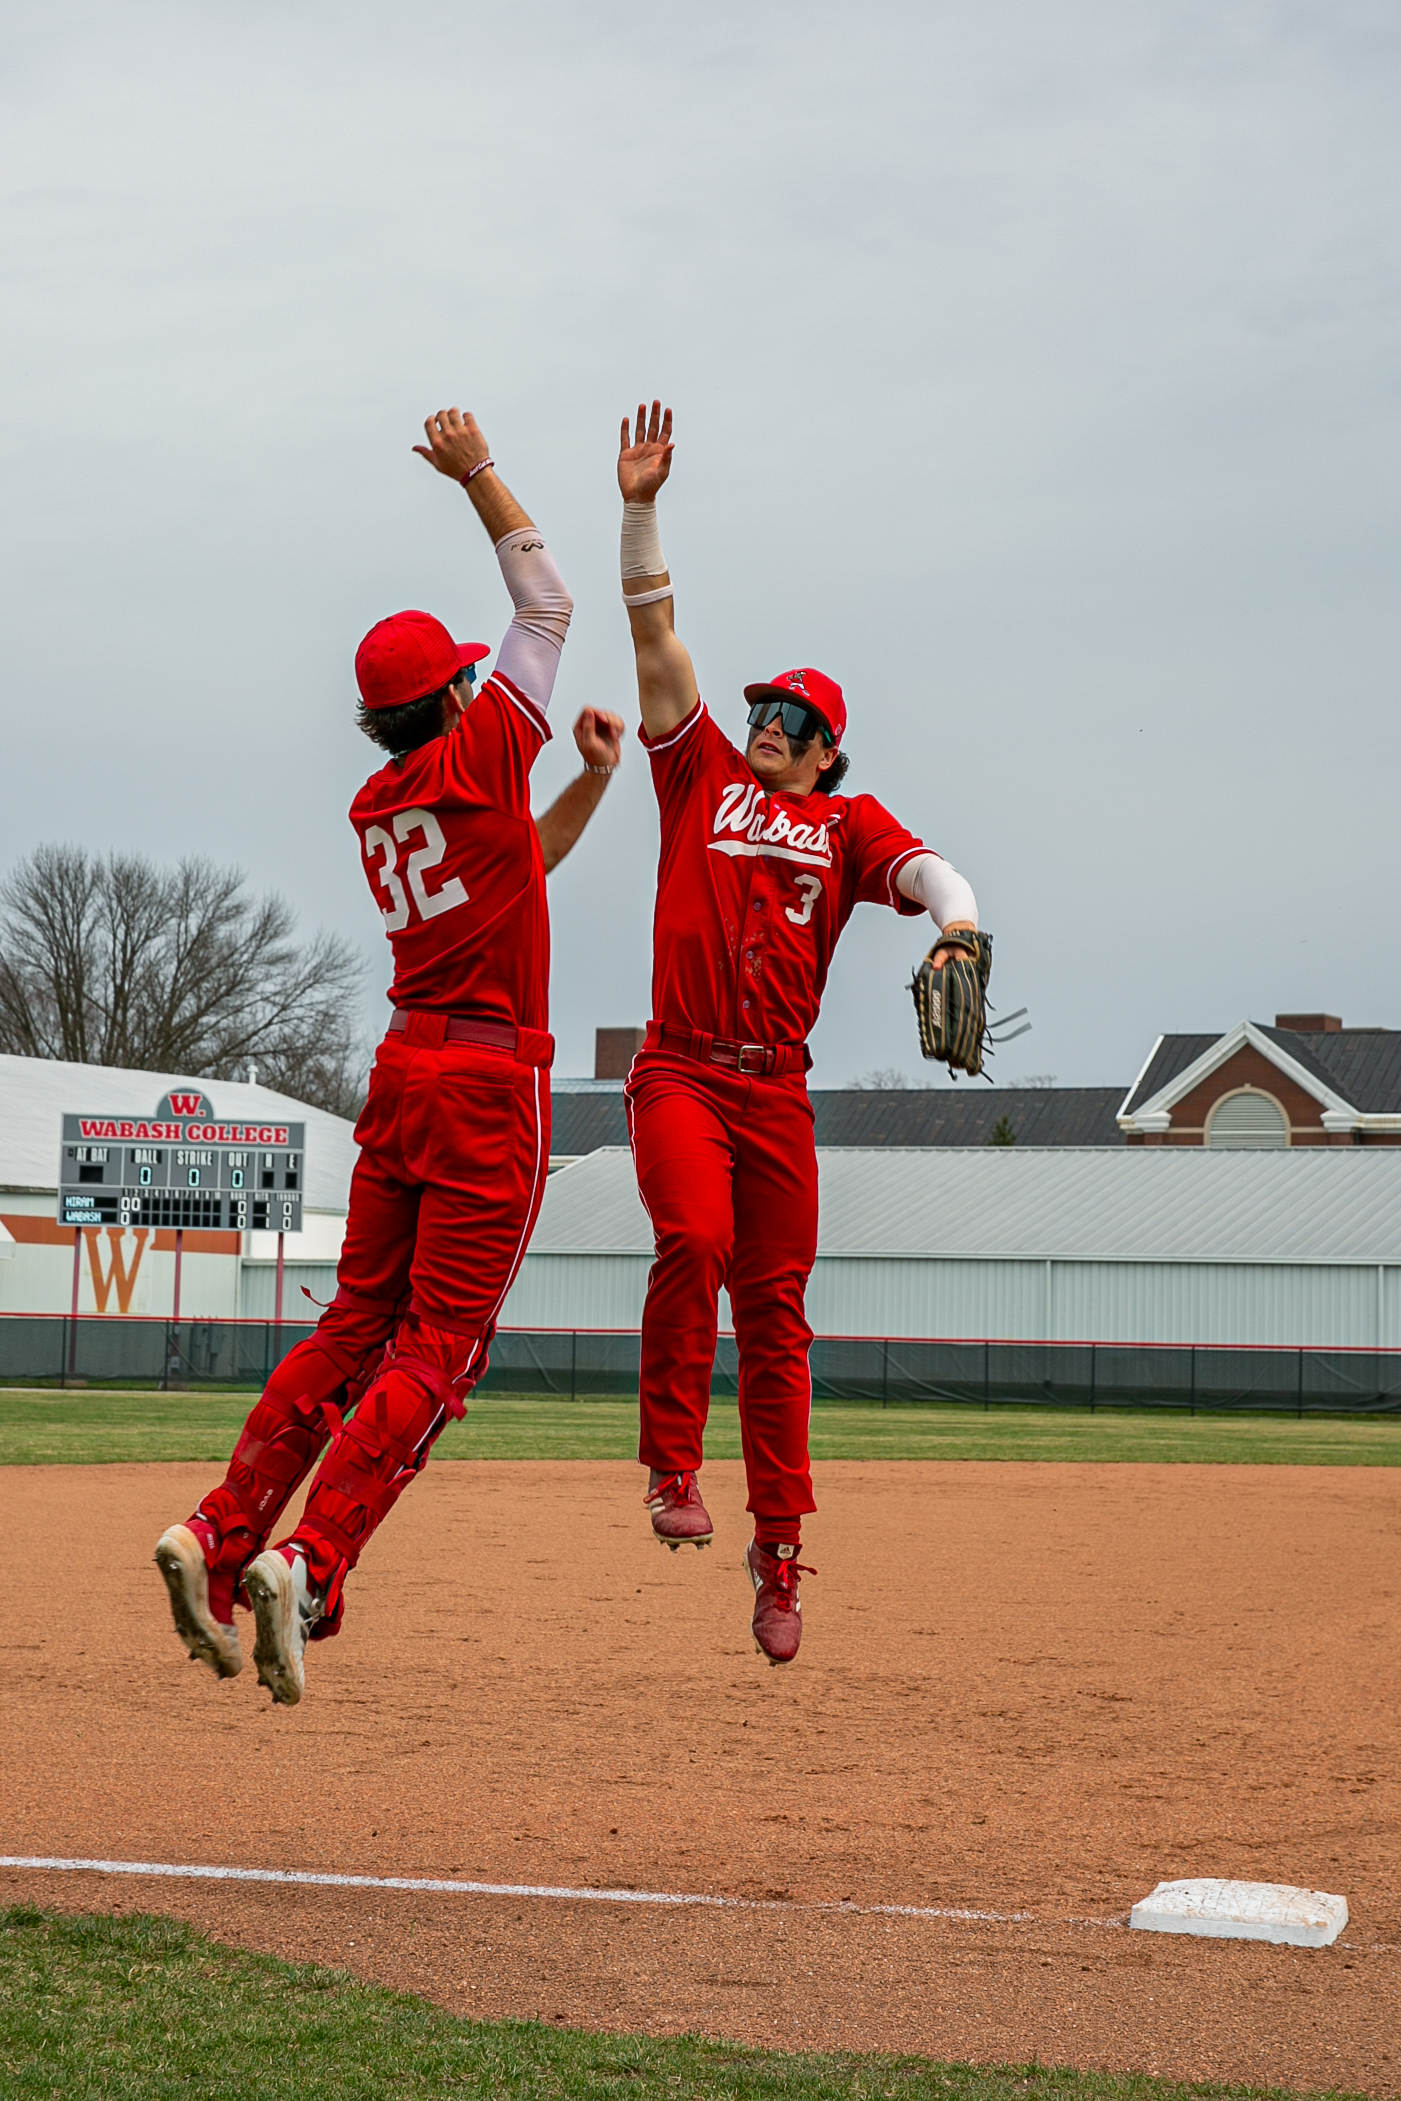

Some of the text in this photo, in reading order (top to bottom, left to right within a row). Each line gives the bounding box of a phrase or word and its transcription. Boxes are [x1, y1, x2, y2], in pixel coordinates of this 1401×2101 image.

[365, 808, 469, 932] 32
[785, 874, 822, 925] 3
[79, 1118, 288, 1145] WABASH COLLEGE
[76, 1147, 108, 1162] AT BAT
[134, 1148, 158, 1164] BALL
[177, 1150, 212, 1166] STRIKE
[228, 1152, 248, 1167] OUT
[140, 1166, 151, 1185] 0
[188, 1168, 200, 1187] 0
[231, 1169, 243, 1188] 0
[65, 1196, 95, 1208] HIRAM
[237, 1200, 247, 1214] 0
[283, 1201, 292, 1216] 0
[65, 1210, 102, 1222] WABASH
[120, 1211, 130, 1226] 0
[237, 1214, 247, 1229] 0
[282, 1216, 292, 1230] 0
[82, 1228, 150, 1313] W
